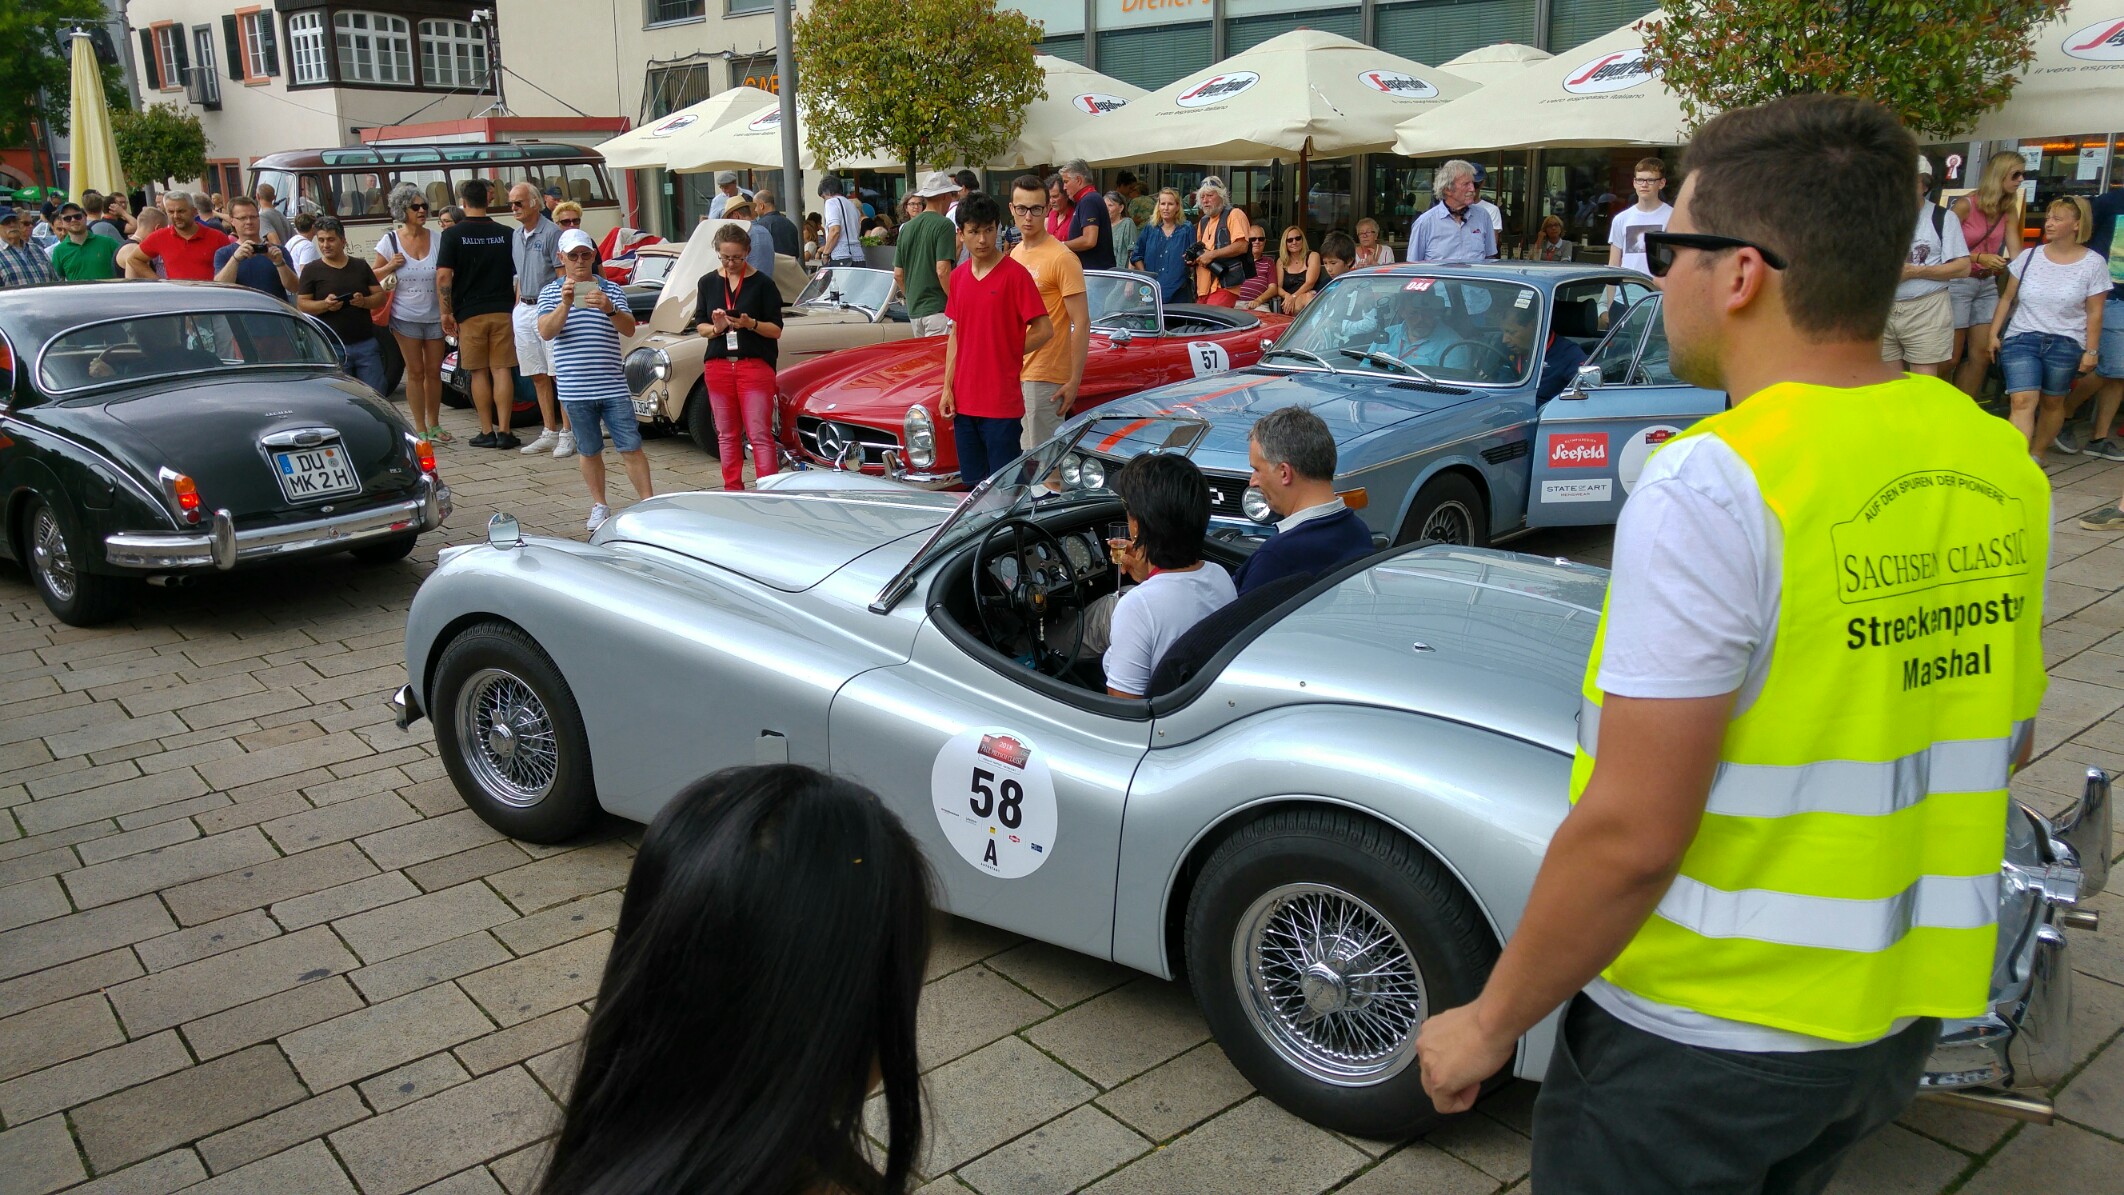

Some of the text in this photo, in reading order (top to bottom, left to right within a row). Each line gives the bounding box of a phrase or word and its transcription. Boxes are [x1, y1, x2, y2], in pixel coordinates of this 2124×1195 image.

[462, 235, 505, 245] RALLYE TEAM
[1201, 350, 1218, 370] 57
[296, 452, 325, 472] DU
[1552, 443, 1605, 462] Seefeld
[289, 473, 317, 494] MK
[1864, 475, 2006, 523] AUF DEN SPUREN DER PIONIERE
[1844, 528, 2027, 593] SACHSEN CLASSIC
[970, 766, 1023, 829] 58
[983, 838, 998, 867] A
